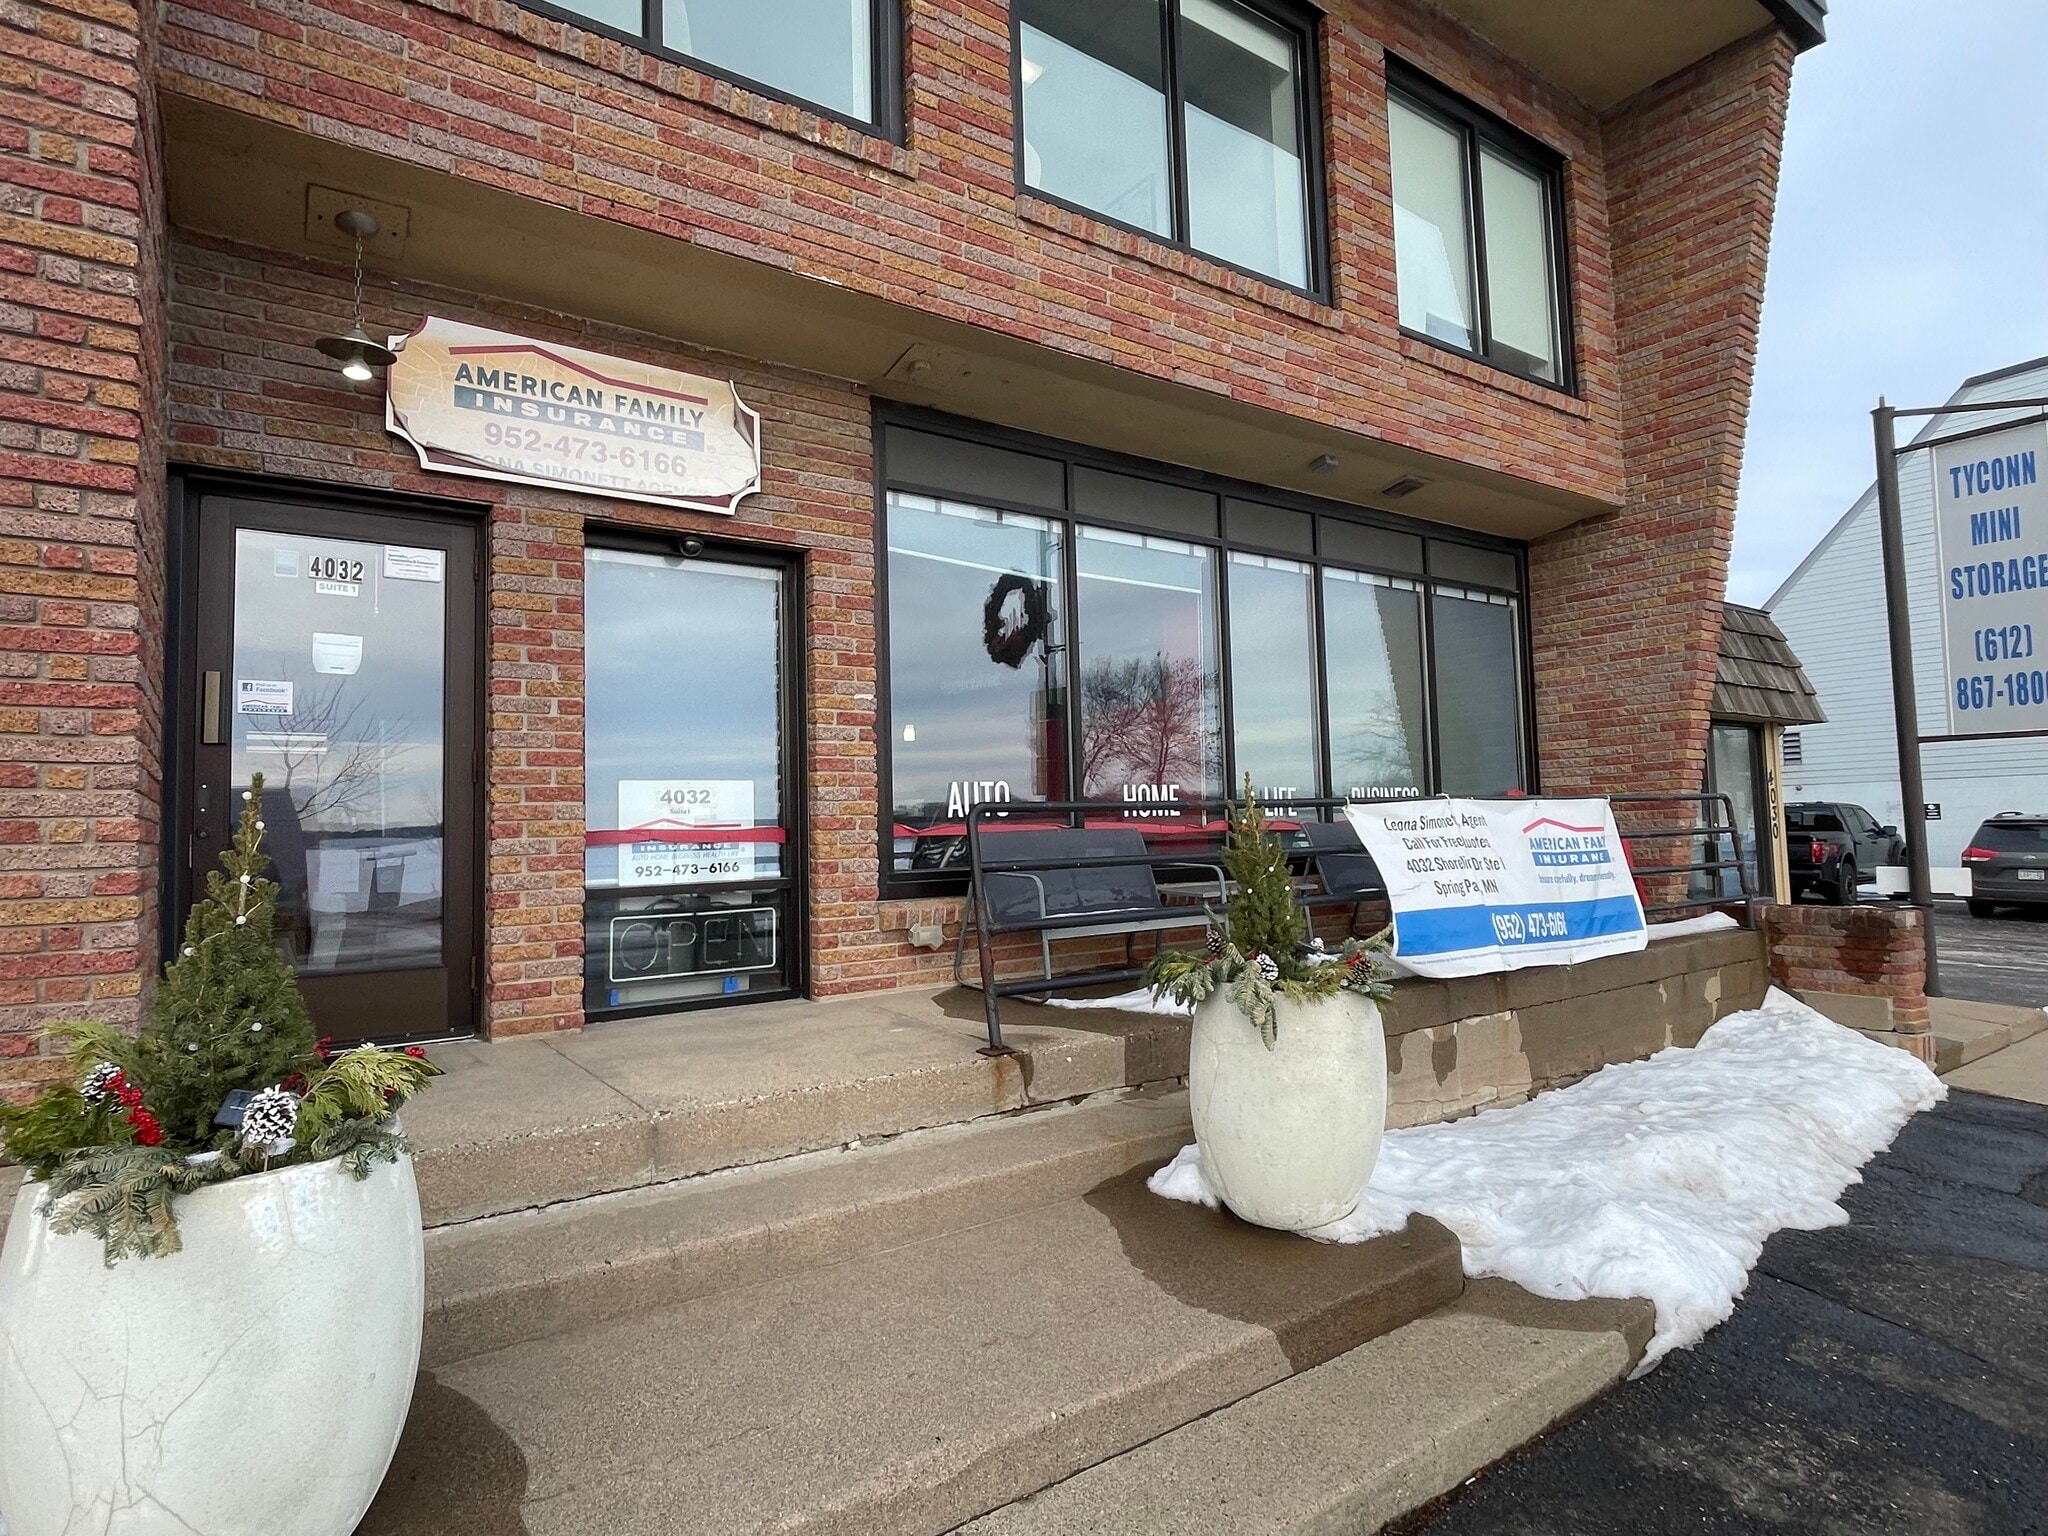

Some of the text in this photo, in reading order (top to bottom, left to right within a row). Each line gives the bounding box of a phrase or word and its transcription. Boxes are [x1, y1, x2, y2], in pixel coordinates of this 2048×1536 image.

[454, 363, 704, 428] AMERICAN FAMILY
[475, 393, 688, 446] INSURANCE
[484, 422, 687, 478] 952-473-6166
[1950, 451, 2037, 498] TYCONN
[1971, 506, 2021, 546] MINI
[311, 556, 363, 582] 4032
[1951, 554, 2048, 600] STORAGE
[319, 582, 350, 593] SUITE
[1975, 624, 2032, 662] (612)
[660, 789, 711, 804] 4032
[947, 780, 1010, 818] AUTO
[1123, 784, 1180, 817] HOME
[1264, 786, 1298, 817] LIFE
[1768, 769, 1779, 839] 4030
[640, 842, 732, 852] INSURANCE
[1402, 837, 1425, 850] Call
[1423, 836, 1441, 848] For
[635, 862, 740, 877] 952-473-6166
[1407, 857, 1435, 873] 4032
[1434, 880, 1466, 897] Spring
[1481, 879, 1500, 894] MN
[620, 917, 769, 971] OPEN
[1492, 911, 1525, 945] (952)
